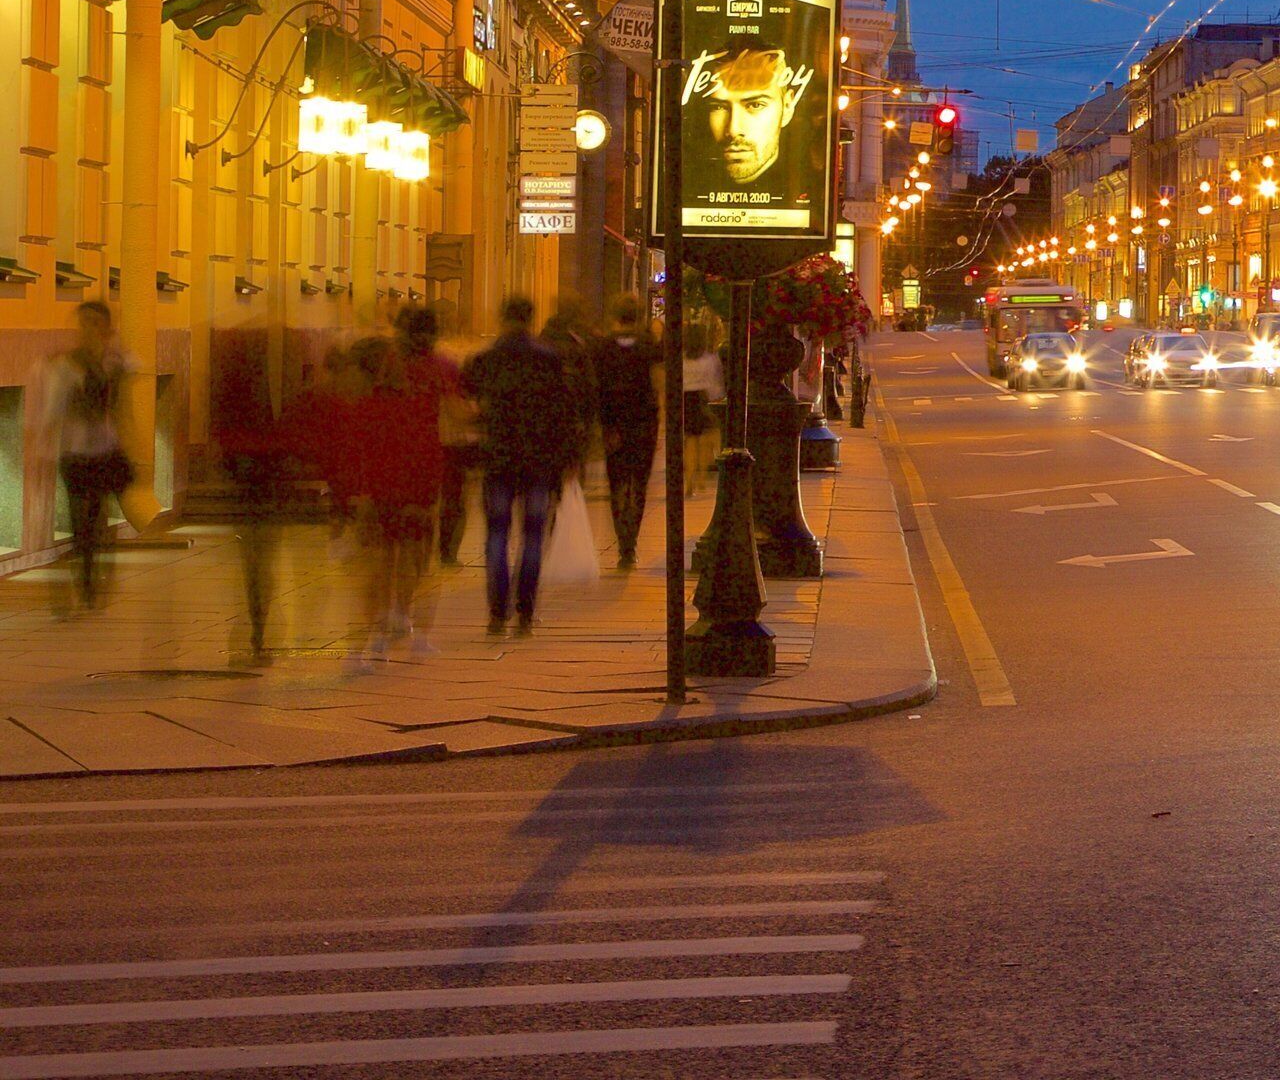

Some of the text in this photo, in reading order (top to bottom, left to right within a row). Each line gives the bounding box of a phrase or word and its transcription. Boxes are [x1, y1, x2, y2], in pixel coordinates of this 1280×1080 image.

[731, 2, 758, 13] БИРЖА
[729, 25, 759, 34] PIANO BAR
[709, 192, 770, 203] 9 АВГУСТА 20:00
[522, 215, 573, 228] КАФЕ
[701, 212, 741, 223] radario
